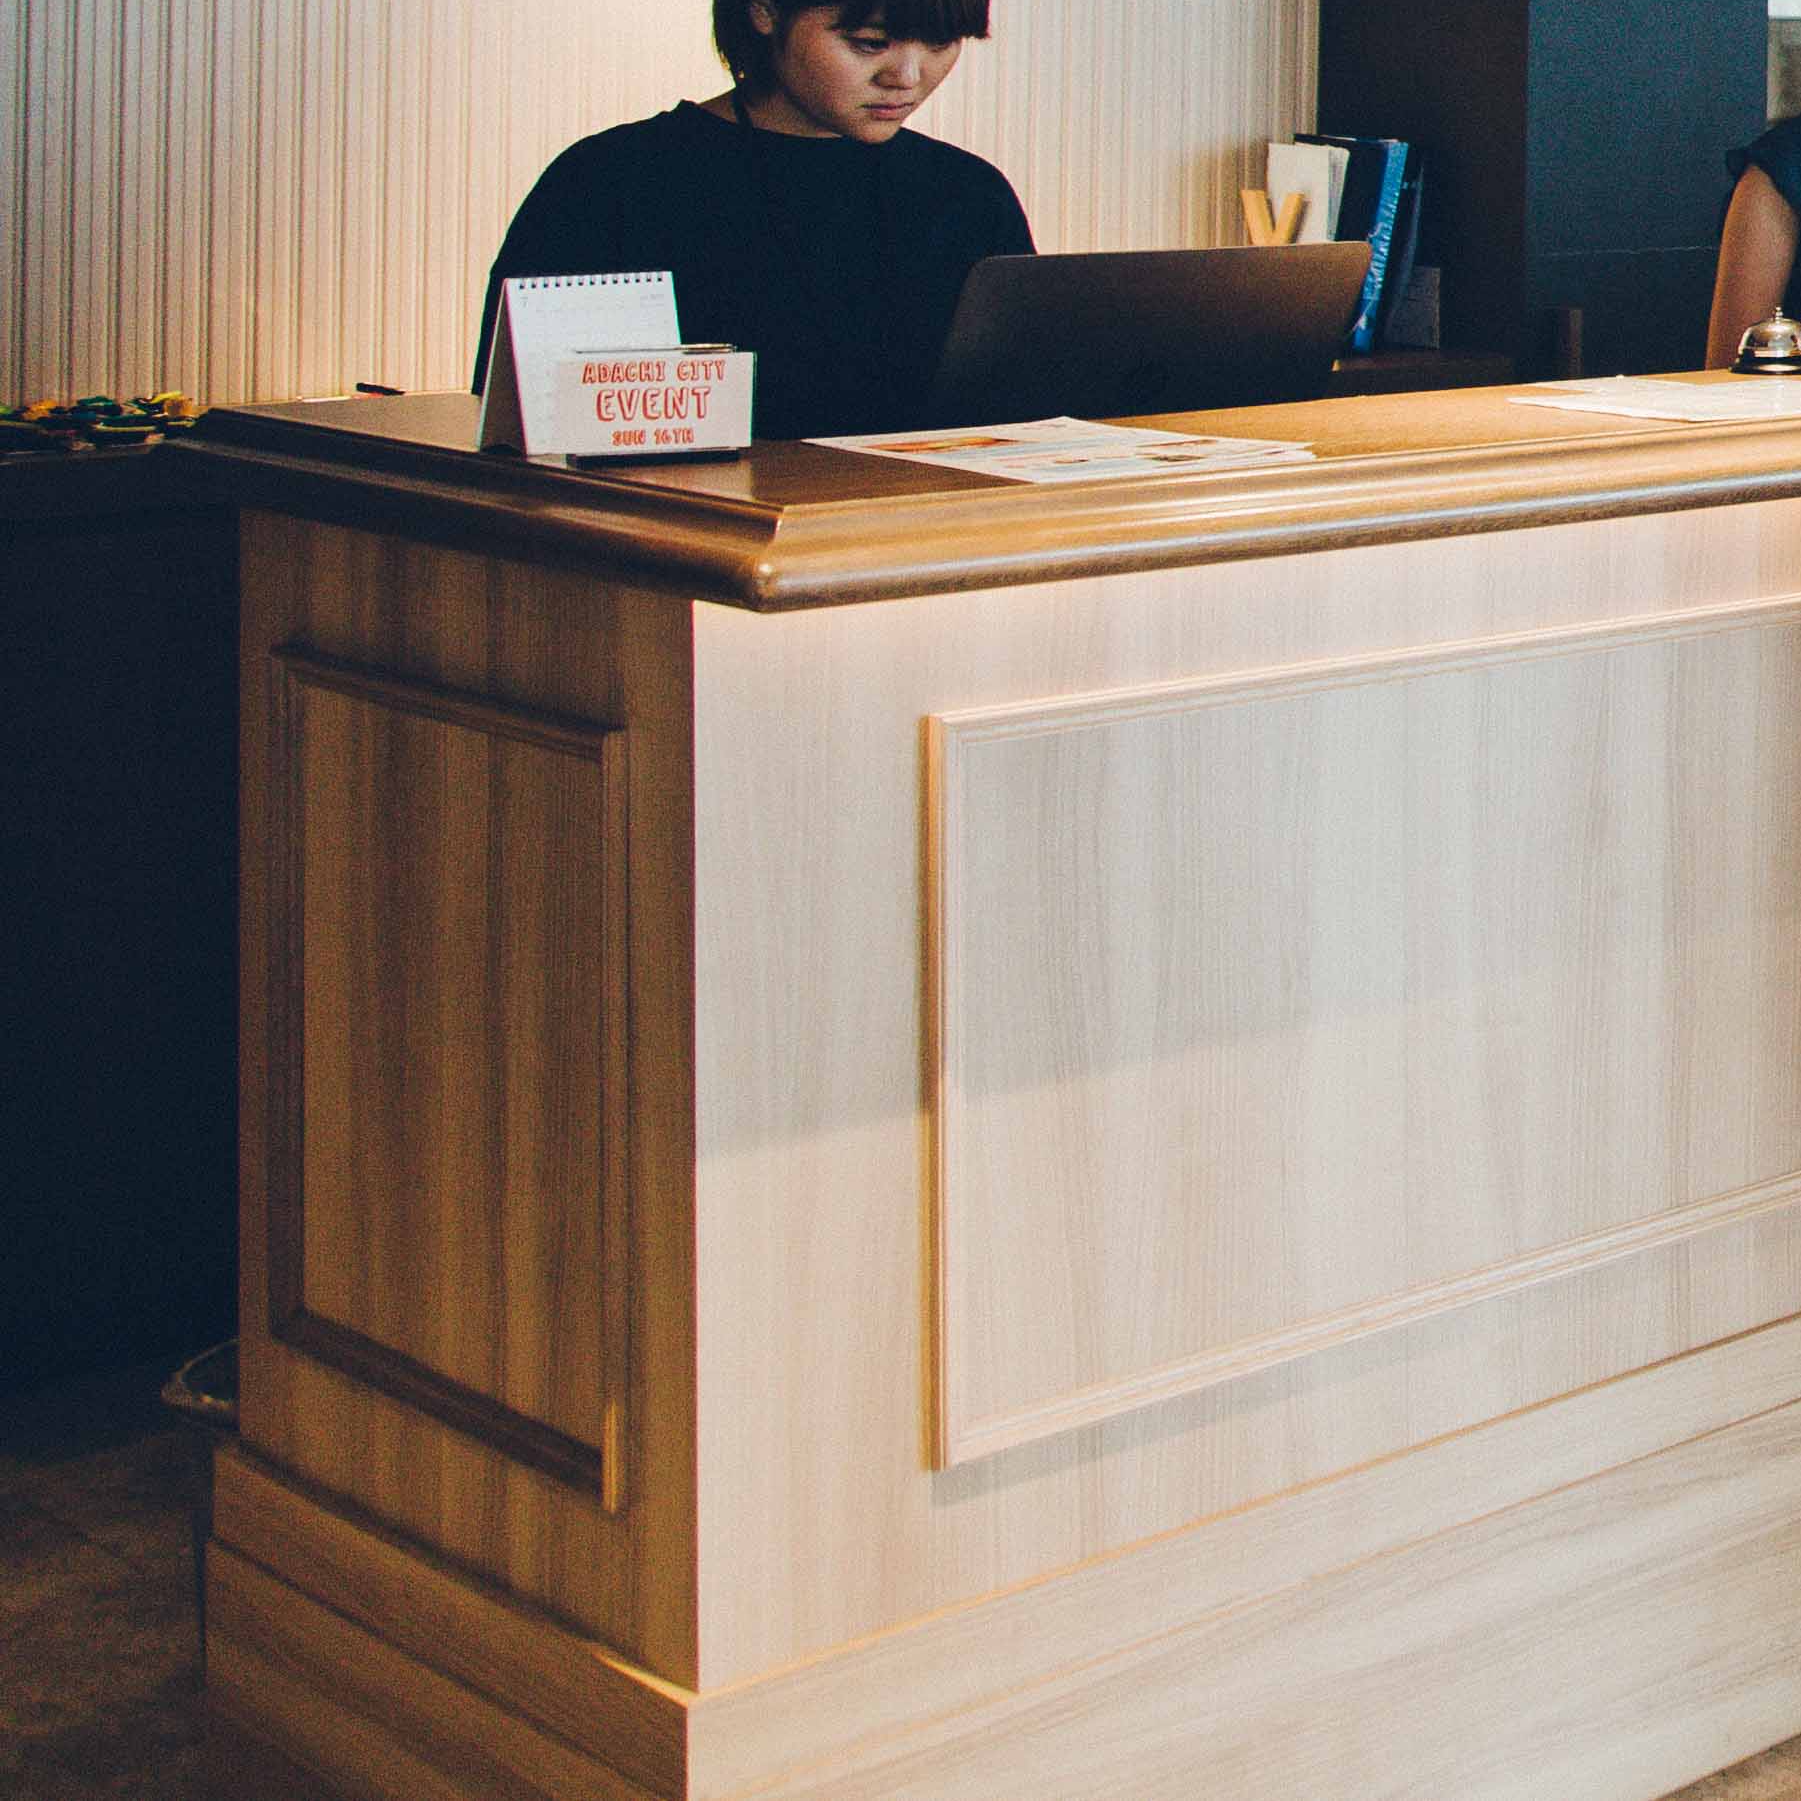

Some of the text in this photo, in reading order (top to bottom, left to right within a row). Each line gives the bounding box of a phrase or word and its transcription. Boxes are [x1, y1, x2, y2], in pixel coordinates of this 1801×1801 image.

[582, 358, 726, 384] ADACHI CITY
[596, 386, 712, 422] EVENT
[612, 429, 647, 447] SUN
